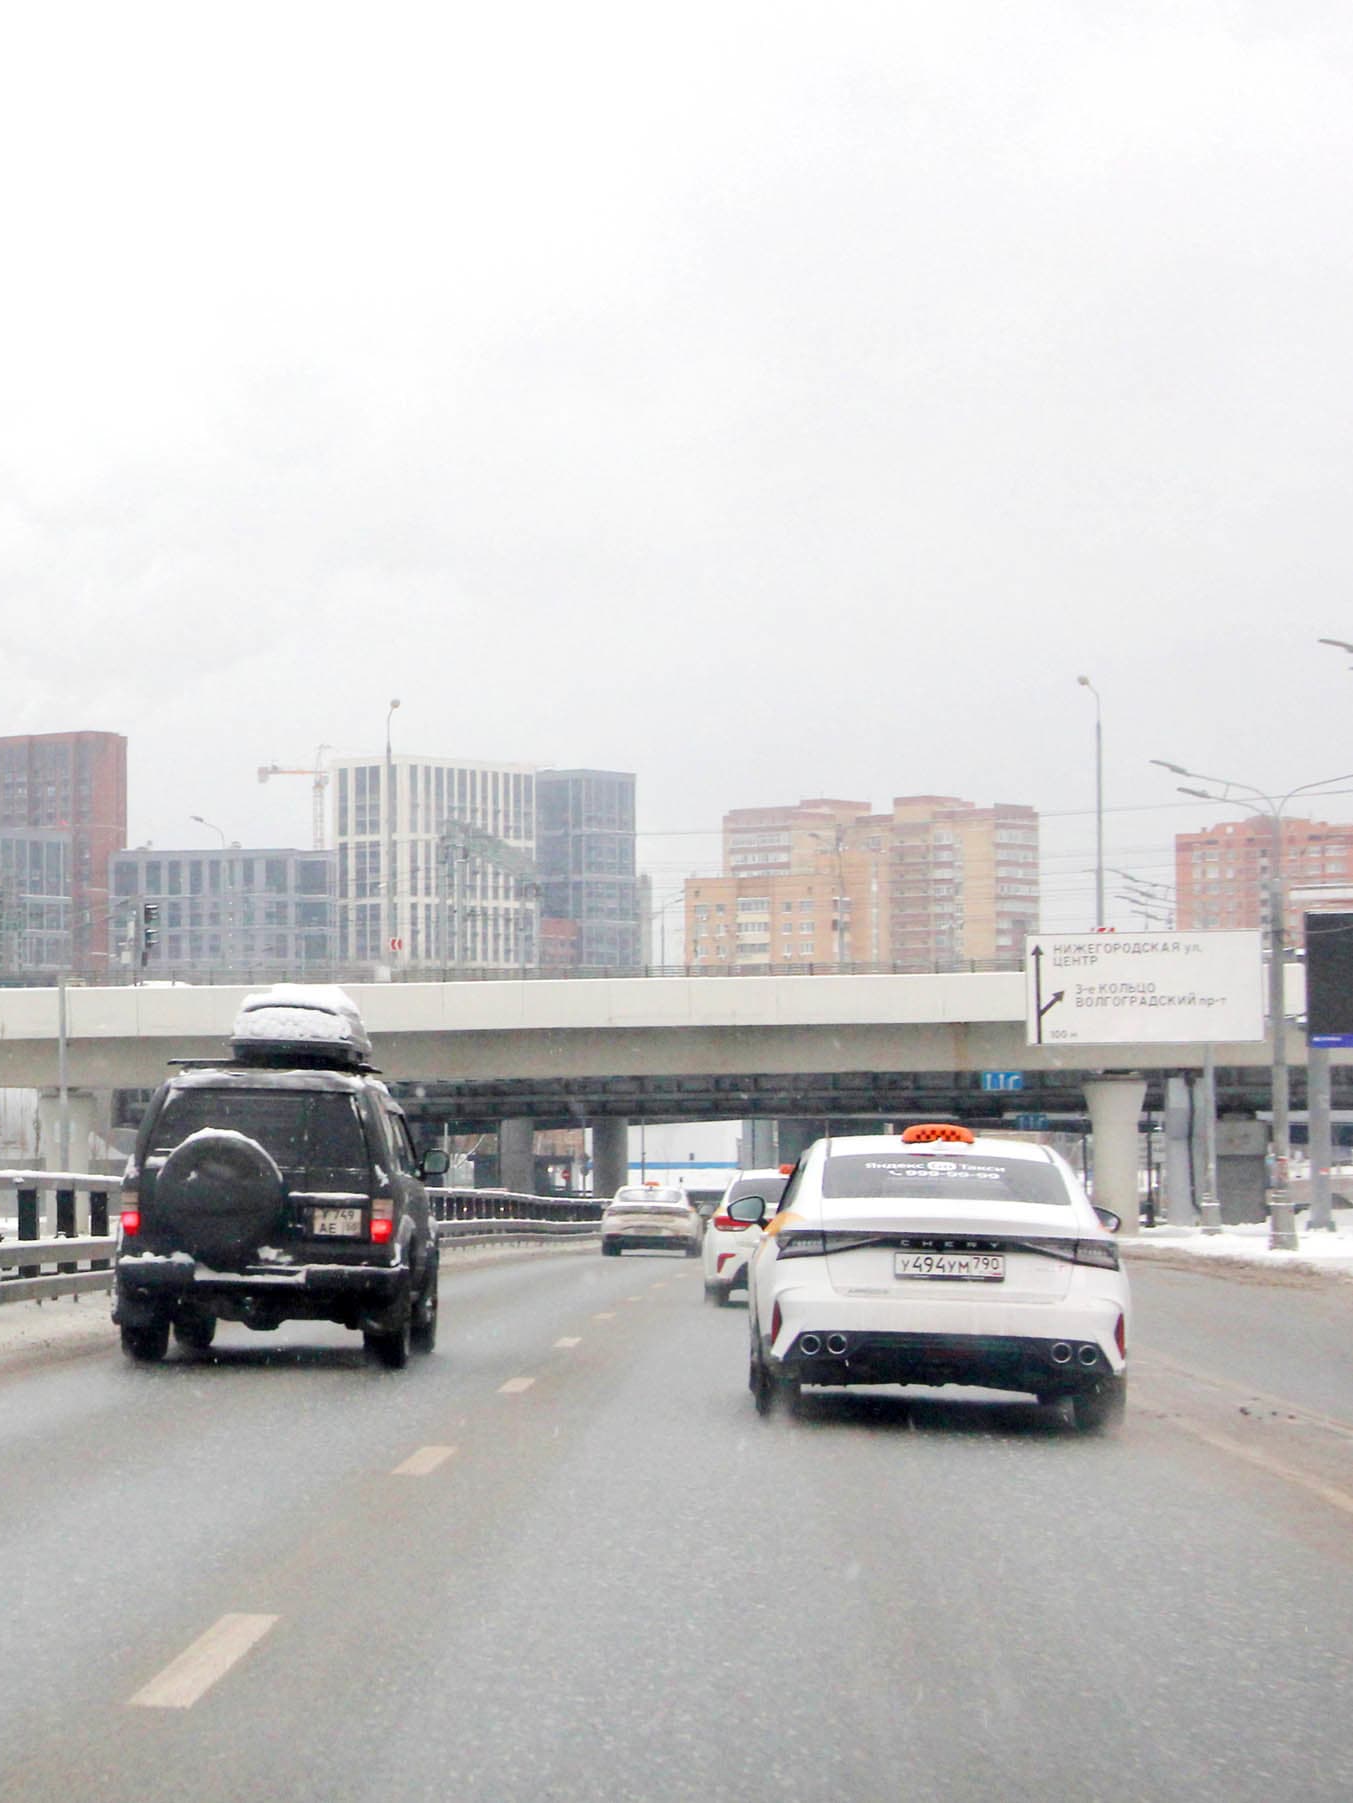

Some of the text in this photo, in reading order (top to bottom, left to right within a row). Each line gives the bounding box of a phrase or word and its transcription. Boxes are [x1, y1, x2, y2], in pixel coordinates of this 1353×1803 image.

[1053, 942, 1203, 955] НИЖЕГОРОДСКАЯ ул.
[1053, 955, 1098, 967] ЦЕНТР
[1075, 983, 1156, 995] 3-е КОЛЬЦО
[1076, 993, 1228, 1008] ВОЛГОГРАДСКИЙ пр-т
[1050, 1030, 1068, 1039] 100
[864, 1162, 925, 1170] Яндекс
[959, 1163, 1006, 1172] Такси
[905, 1170, 1001, 1180] 999-99-99
[900, 1239, 998, 1248] CHERY
[972, 1256, 999, 1270] 790
